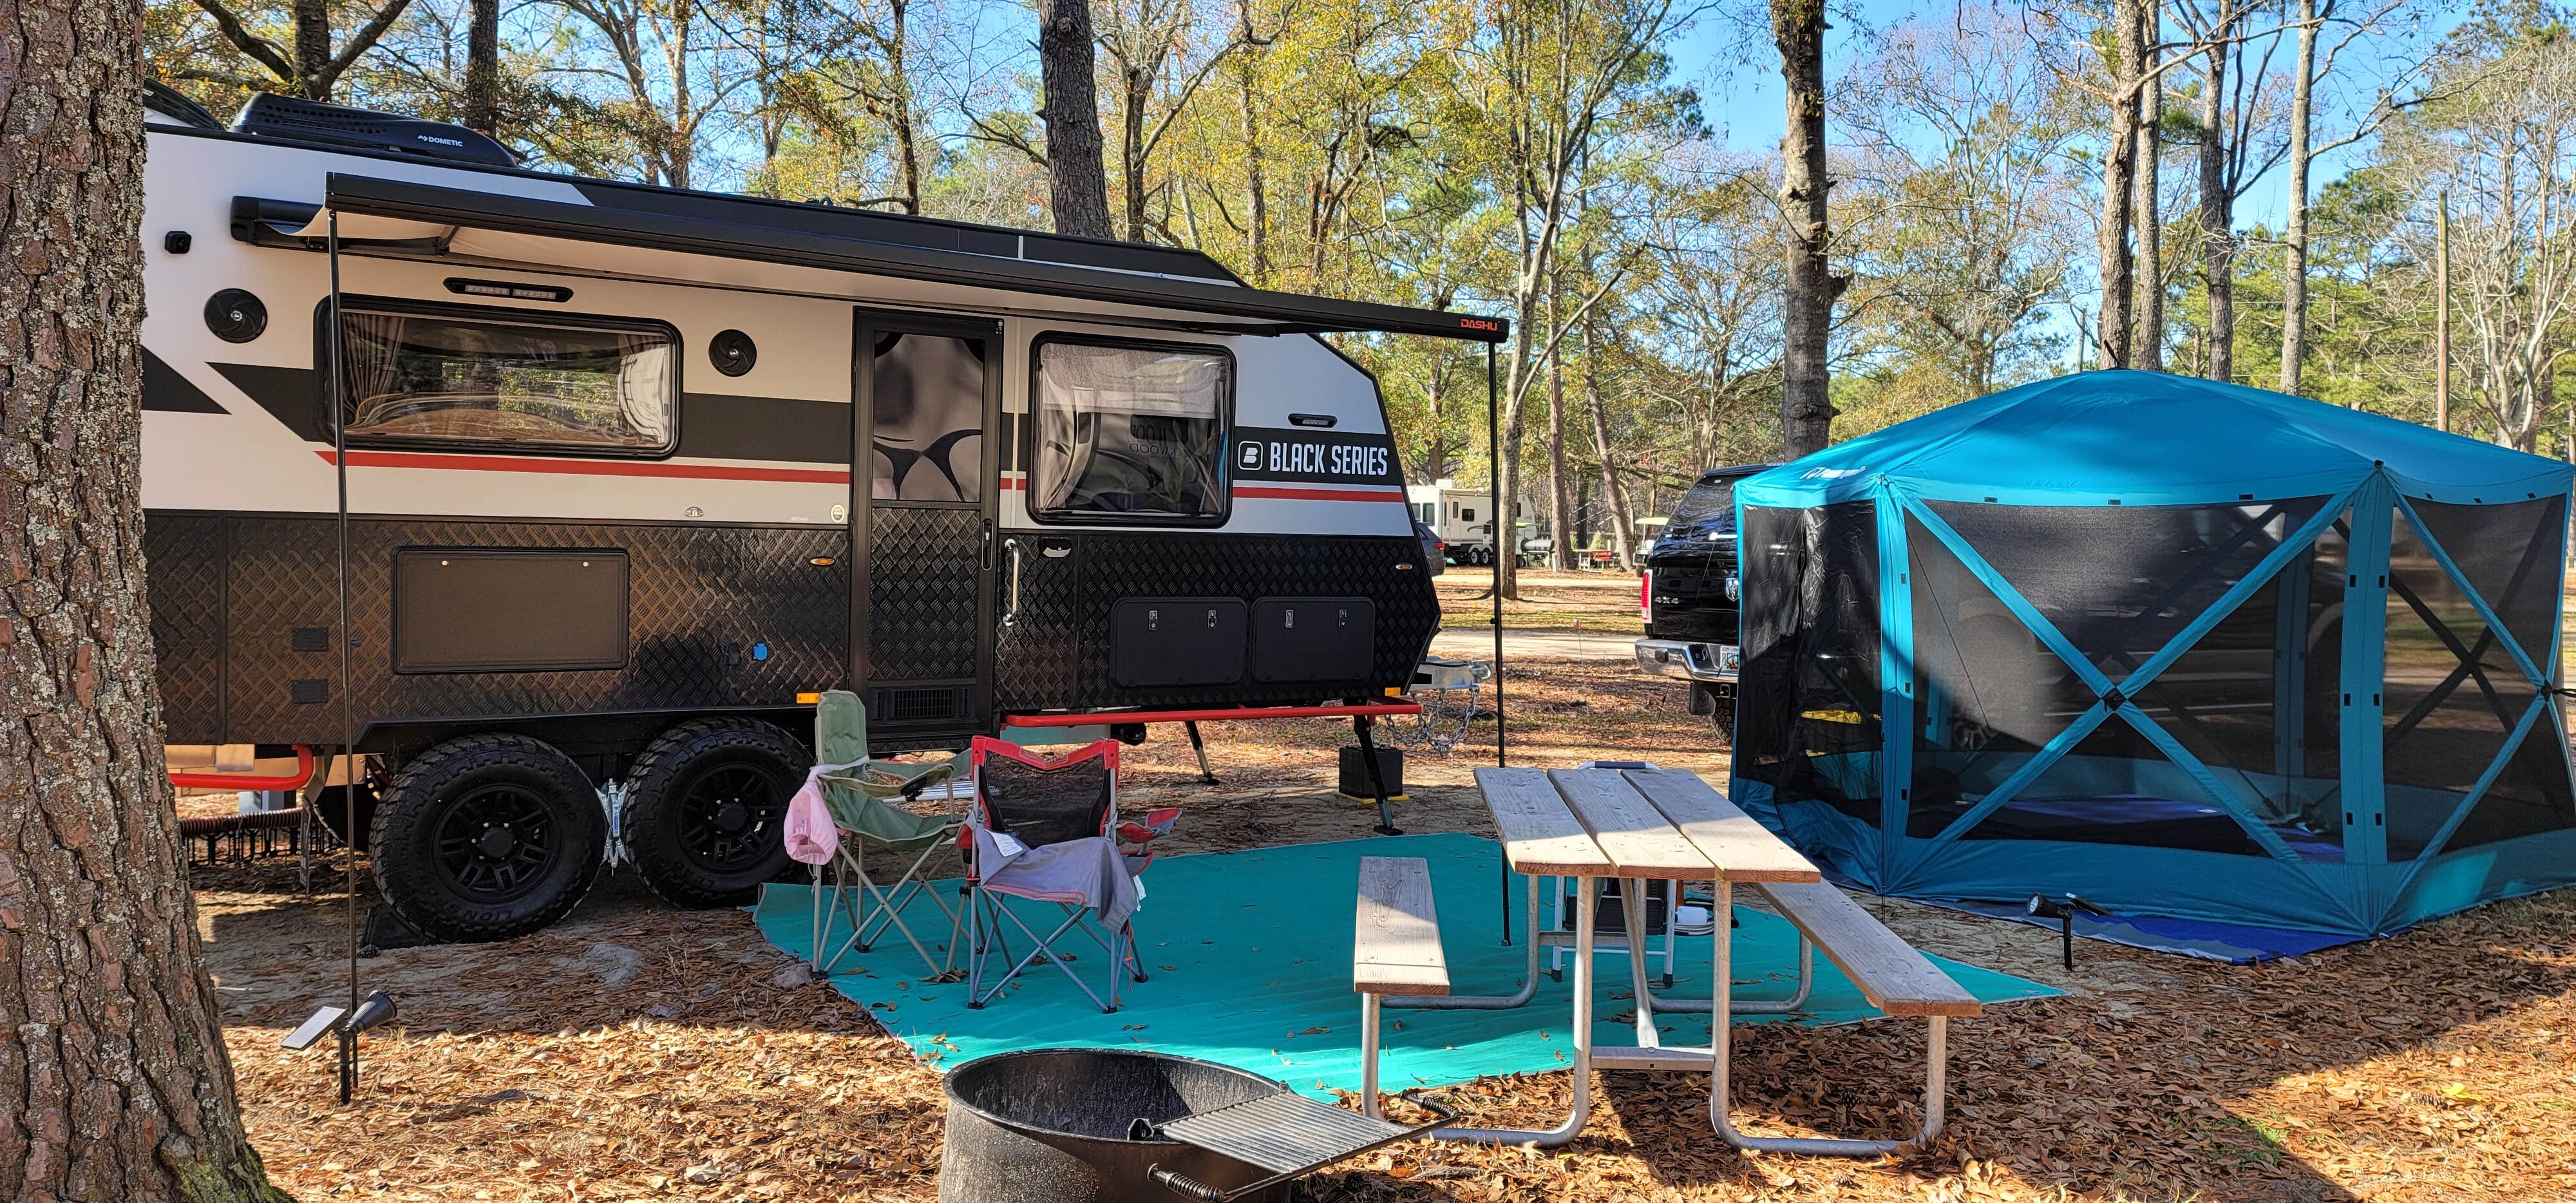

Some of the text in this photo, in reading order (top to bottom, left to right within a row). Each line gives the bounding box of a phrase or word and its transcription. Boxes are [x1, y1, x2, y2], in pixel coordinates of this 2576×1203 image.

[428, 136, 464, 147] DOMETIC
[1461, 318, 1498, 331] DASHU
[1269, 442, 1325, 474] BLACK
[1331, 445, 1388, 476] SERIES
